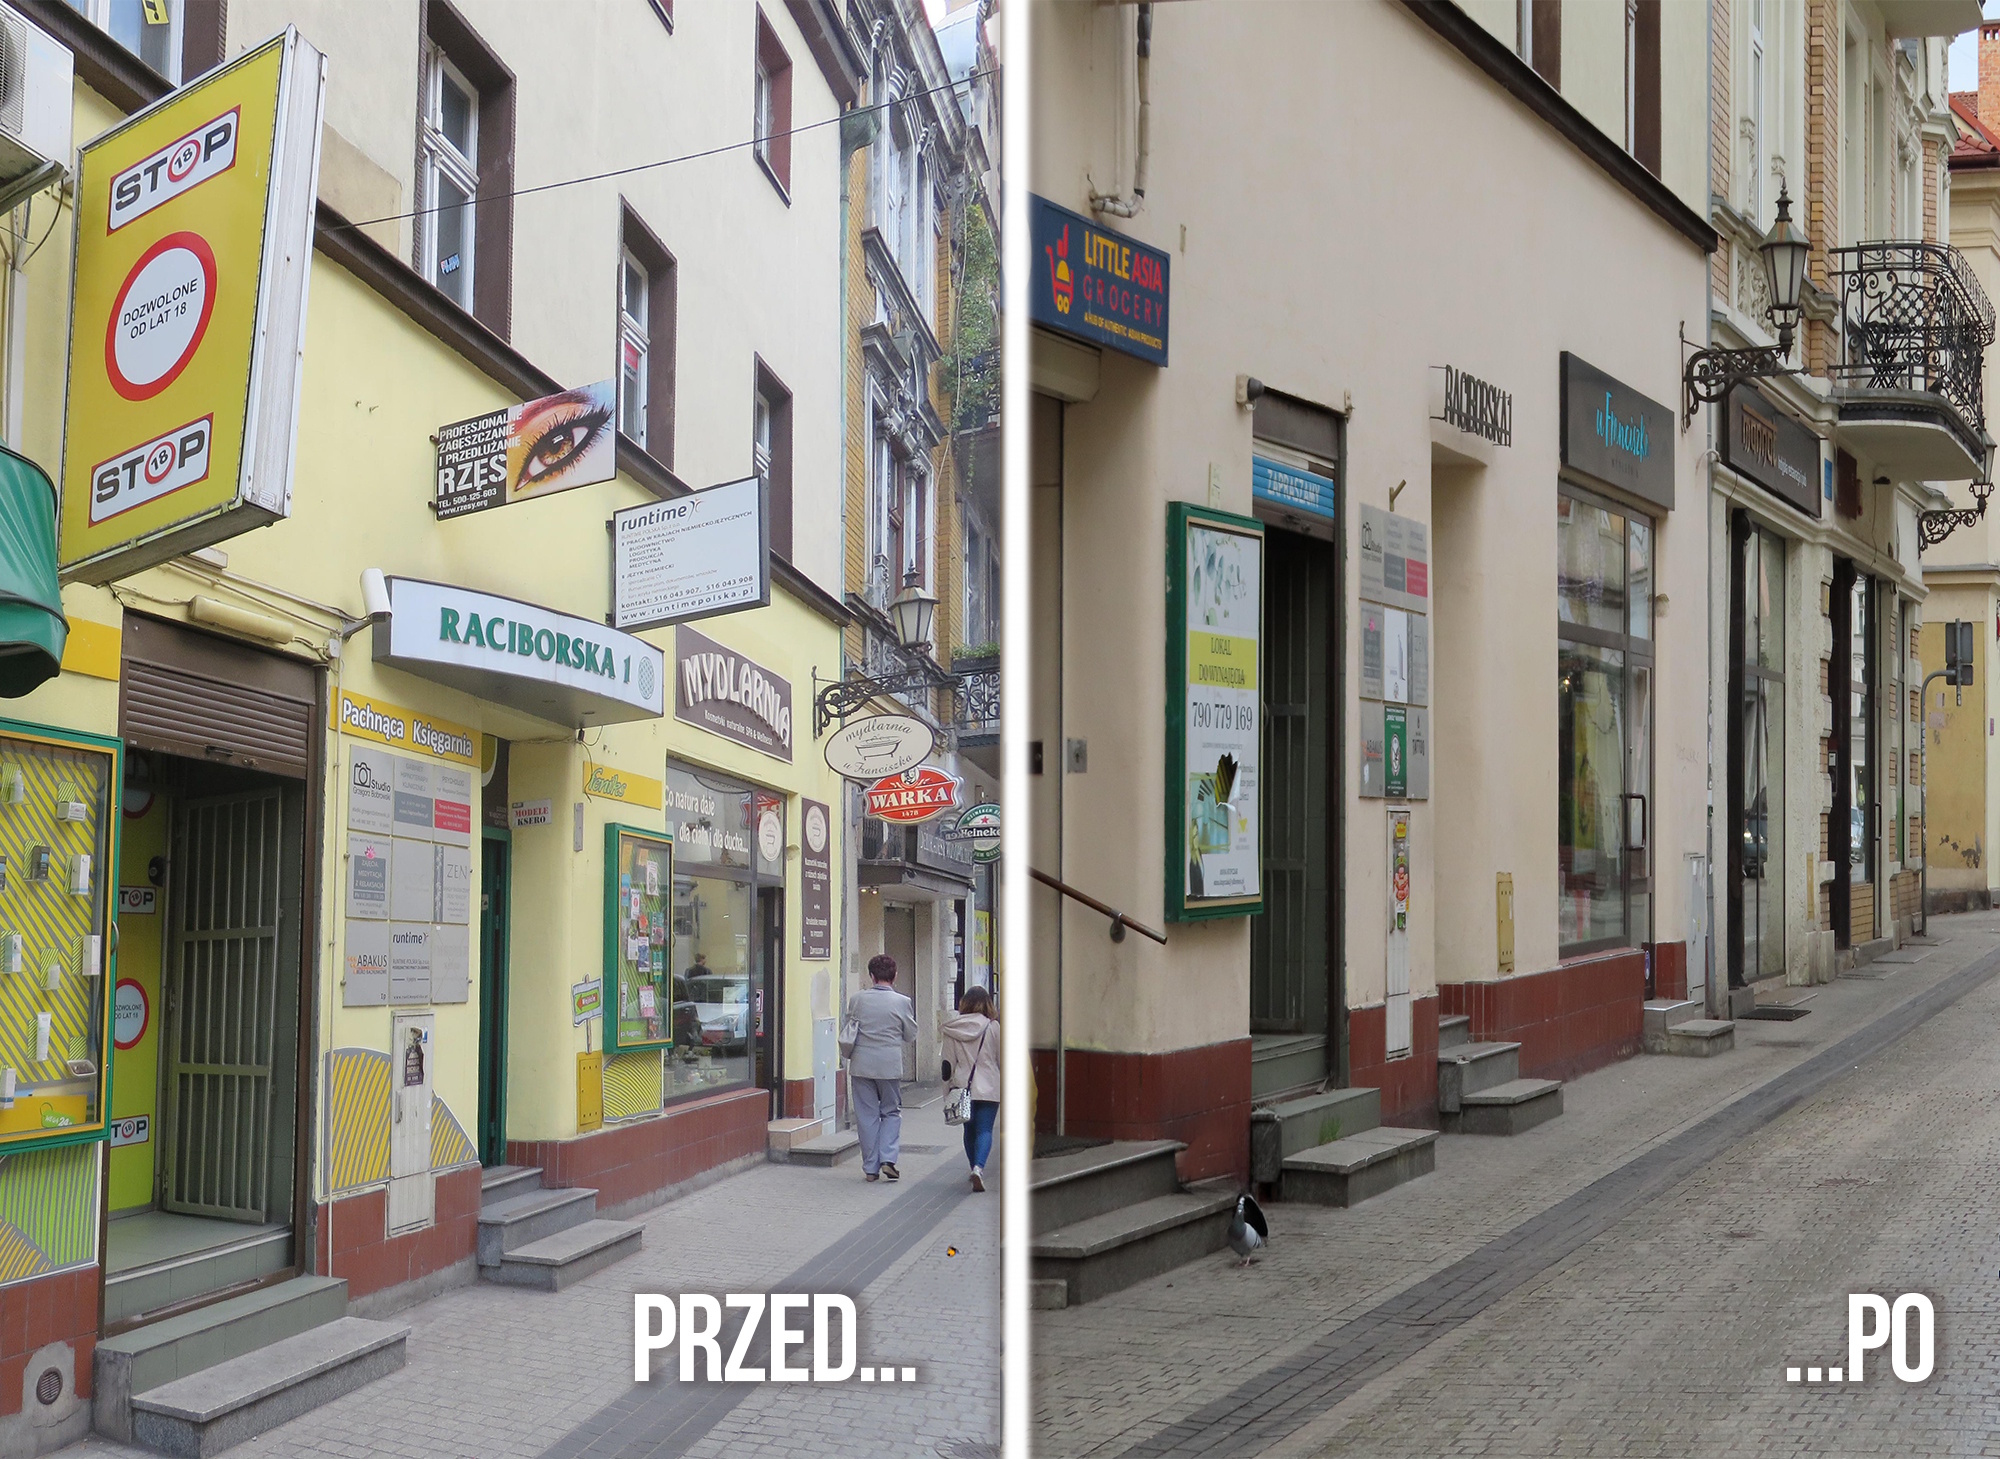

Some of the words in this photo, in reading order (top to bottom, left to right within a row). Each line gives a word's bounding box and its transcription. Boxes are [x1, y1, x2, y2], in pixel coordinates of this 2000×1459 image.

[174, 148, 194, 170] 18
[1084, 230, 1130, 280] LITTLE
[1131, 252, 1163, 294] ASIA
[123, 278, 198, 327] DOZWOLONE
[1083, 274, 1163, 328] GROCERY
[130, 322, 147, 340] OD
[149, 310, 172, 331] LAT
[174, 302, 187, 318] 18
[1444, 364, 1508, 447] RACIBORSKA
[439, 412, 523, 442] PROFESJONALNE
[1596, 407, 1604, 437] u
[438, 424, 516, 454] ZAGĘSZCZANIE
[151, 450, 168, 471] 18
[438, 456, 443, 467] I
[437, 454, 508, 496] RZĘS
[453, 488, 497, 506] 500-125-603
[1267, 468, 1320, 508] ZAPRASZAMY
[438, 500, 488, 517] www.rzesy.org
[621, 506, 687, 532] runtime
[626, 538, 646, 546] PRACA
[654, 529, 680, 539] KRAJACH
[629, 537, 676, 552] BUDOWNICTWO
[629, 546, 662, 558] LOGISTYKA
[629, 552, 664, 564] PRODUKCJA
[629, 558, 662, 569] MEDYCYNA
[644, 564, 675, 574] NIEMIECKI
[621, 598, 652, 609] kontakt:
[654, 594, 668, 602] 516
[706, 582, 720, 592] 516
[722, 578, 737, 588] 043
[738, 574, 754, 584] 908
[621, 586, 754, 621] www.runtimepolska.pl
[439, 607, 616, 680] RACIBORSKA
[622, 655, 632, 684] 1
[1210, 637, 1232, 656] LOKAL
[1199, 664, 1208, 681] DO
[1208, 665, 1246, 688] WYNAJĘCIA
[681, 652, 790, 749] MYDLARNIA
[1192, 702, 1212, 728] 790
[1214, 704, 1232, 730] 779
[1235, 706, 1252, 731] 169
[342, 698, 404, 741] Pachnąca
[412, 720, 473, 758] Księgarnia
[845, 718, 913, 744] mydlarnia
[843, 761, 850, 770] u
[854, 755, 913, 776] Franciszka
[370, 779, 391, 793] Studio
[676, 792, 699, 813] natura
[870, 786, 950, 810] WARKA
[515, 806, 549, 818] MODELE
[518, 816, 546, 826] KSERO
[679, 821, 690, 843] dla
[713, 828, 723, 849] dla
[960, 827, 1000, 838] Heineke
[447, 863, 468, 880] ZEN
[119, 888, 154, 907] TOP
[392, 932, 423, 944] runtime
[357, 954, 388, 968] ABAKUS
[114, 1003, 142, 1012] OZWOLONE
[122, 1012, 132, 1020] LAT
[111, 1120, 147, 1140] TOP
